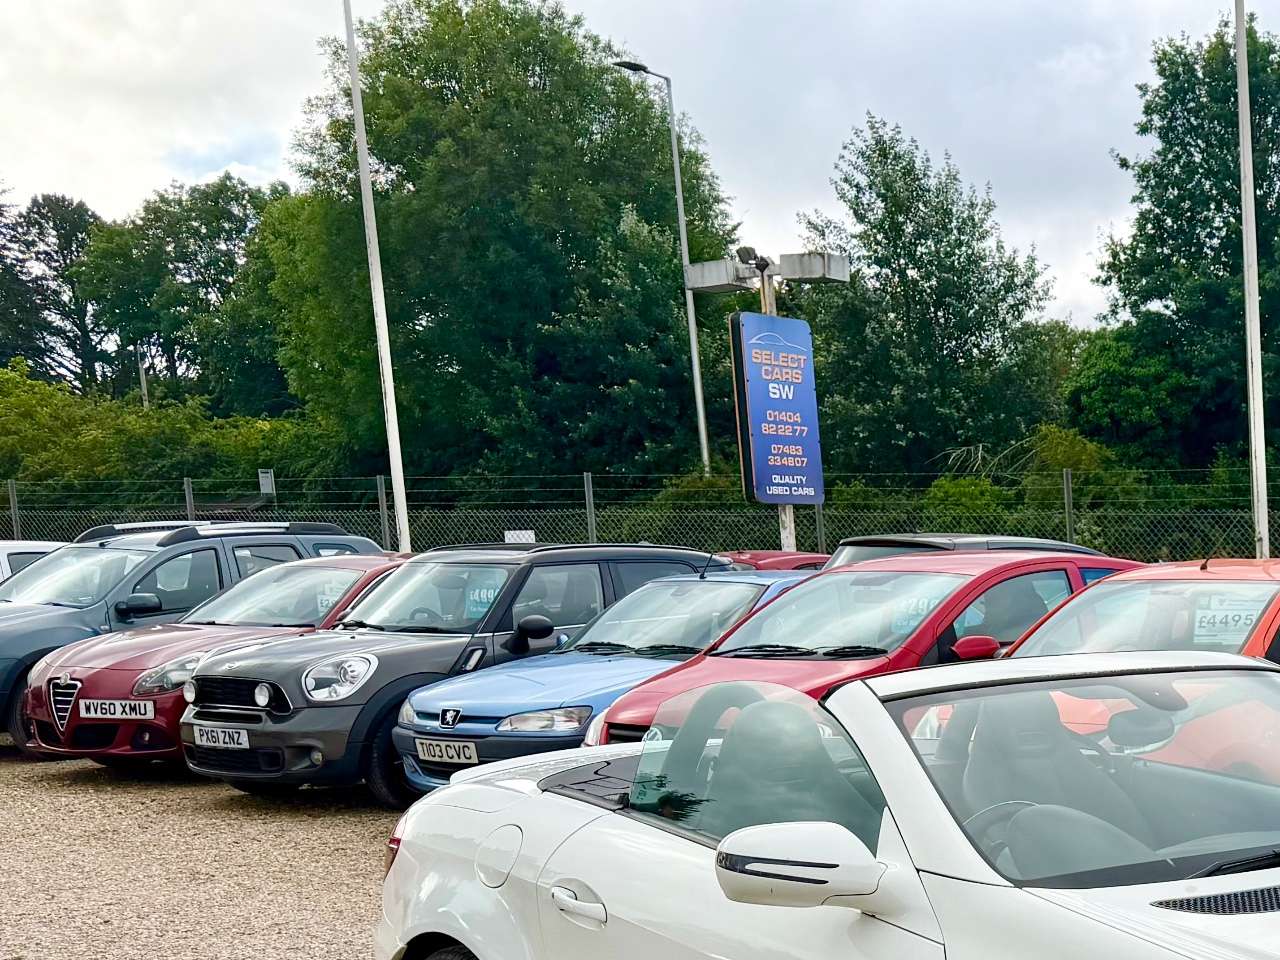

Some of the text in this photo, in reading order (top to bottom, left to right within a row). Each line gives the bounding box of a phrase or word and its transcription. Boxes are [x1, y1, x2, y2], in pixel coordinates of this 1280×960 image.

[752, 349, 808, 369] SELECT
[762, 366, 803, 384] CARS
[769, 383, 794, 400] SW
[766, 410, 802, 423] 01404
[772, 475, 807, 485] QUALITY
[766, 486, 815, 496] USED CARS
[1198, 613, 1255, 628] £4495
[84, 701, 147, 716] WV60 XMU
[199, 728, 243, 746] PX61 ZNZ
[445, 744, 472, 760] CVC
